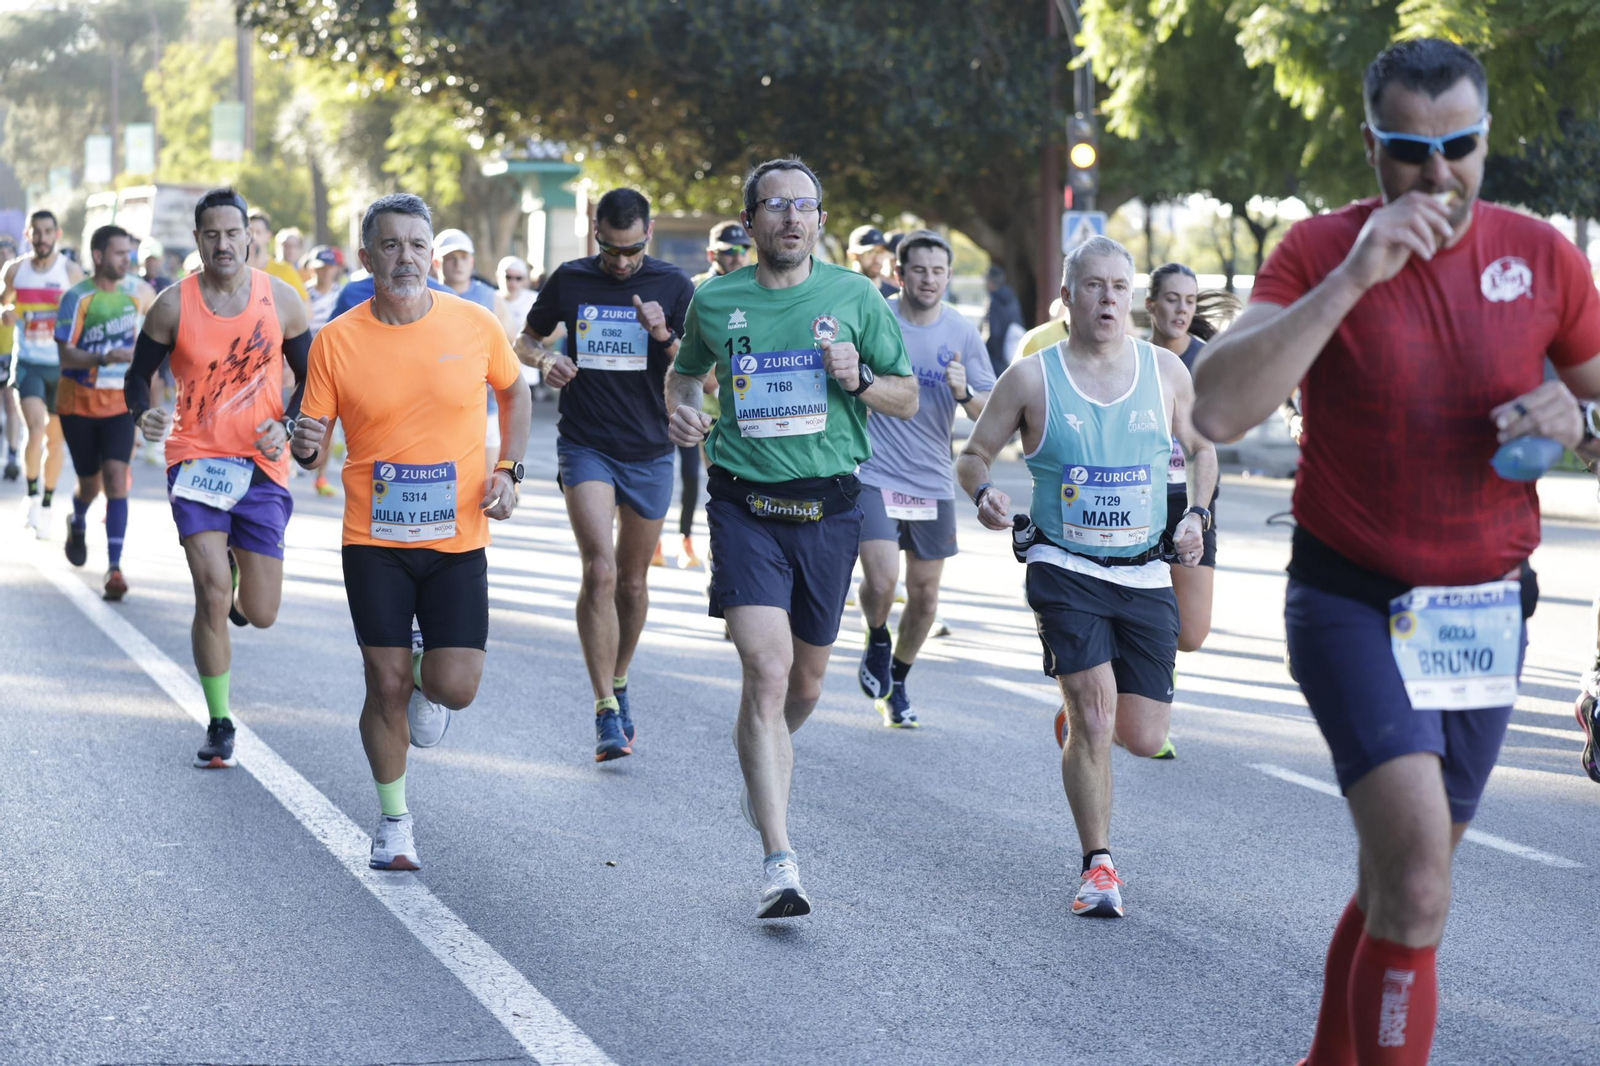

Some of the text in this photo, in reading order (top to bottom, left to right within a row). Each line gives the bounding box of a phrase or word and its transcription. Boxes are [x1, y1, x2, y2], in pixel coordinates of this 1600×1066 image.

[602, 329, 622, 337] 6362
[588, 340, 635, 354] RAFAEL
[724, 336, 751, 359] 13
[763, 355, 813, 368] ZURICH
[766, 381, 793, 393] 7168
[737, 403, 827, 419] JAIMELUCASMANU
[206, 466, 227, 476] 4644
[401, 468, 447, 479] ZURICH
[1094, 471, 1141, 483] ZURICH
[191, 475, 233, 494] PALAO
[402, 492, 427, 502] 5314
[1094, 495, 1121, 506] 7129
[372, 508, 455, 523] JULIA Y ELENA
[1082, 510, 1131, 527] MARK
[1418, 648, 1494, 675] BRUNO
